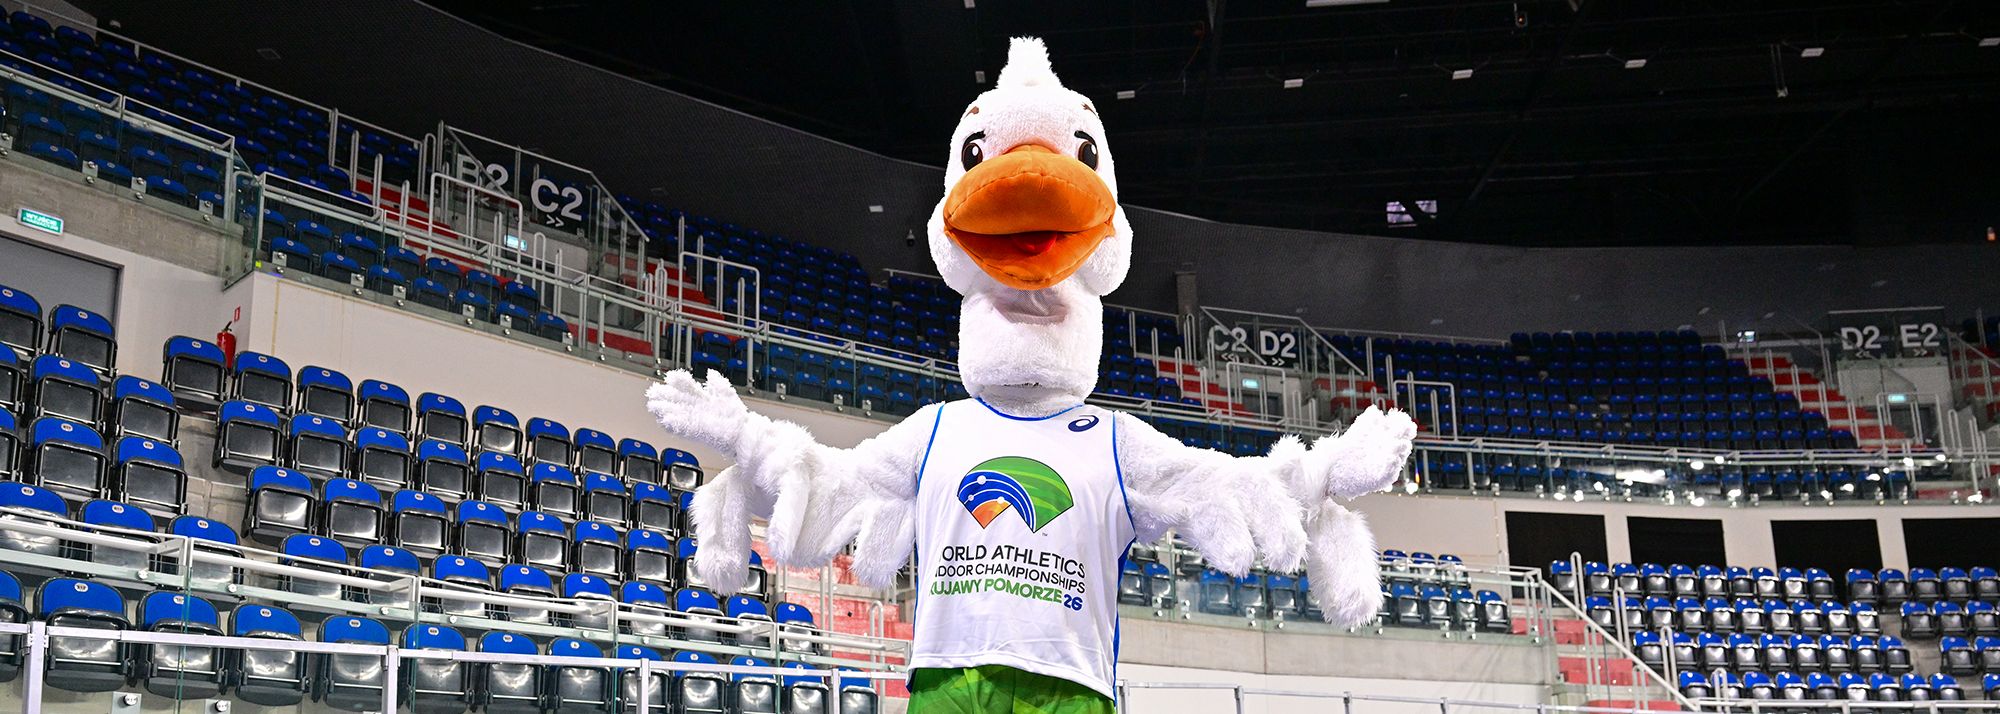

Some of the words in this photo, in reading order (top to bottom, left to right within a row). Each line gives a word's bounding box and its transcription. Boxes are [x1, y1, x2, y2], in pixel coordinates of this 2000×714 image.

[456, 153, 509, 194] B2
[531, 178, 583, 221] C2
[1209, 325, 1247, 353] C2
[1260, 330, 1296, 358] D2
[1841, 325, 1882, 350] D2
[1900, 323, 1940, 348] E2
[940, 545, 987, 562] ORLD
[991, 545, 1086, 579] ATHLETICS
[935, 564, 973, 578] DOOR
[975, 563, 1086, 594] CHAMPIONSHIPS
[984, 577, 1063, 604] POMORZE
[1063, 593, 1083, 611] 26
